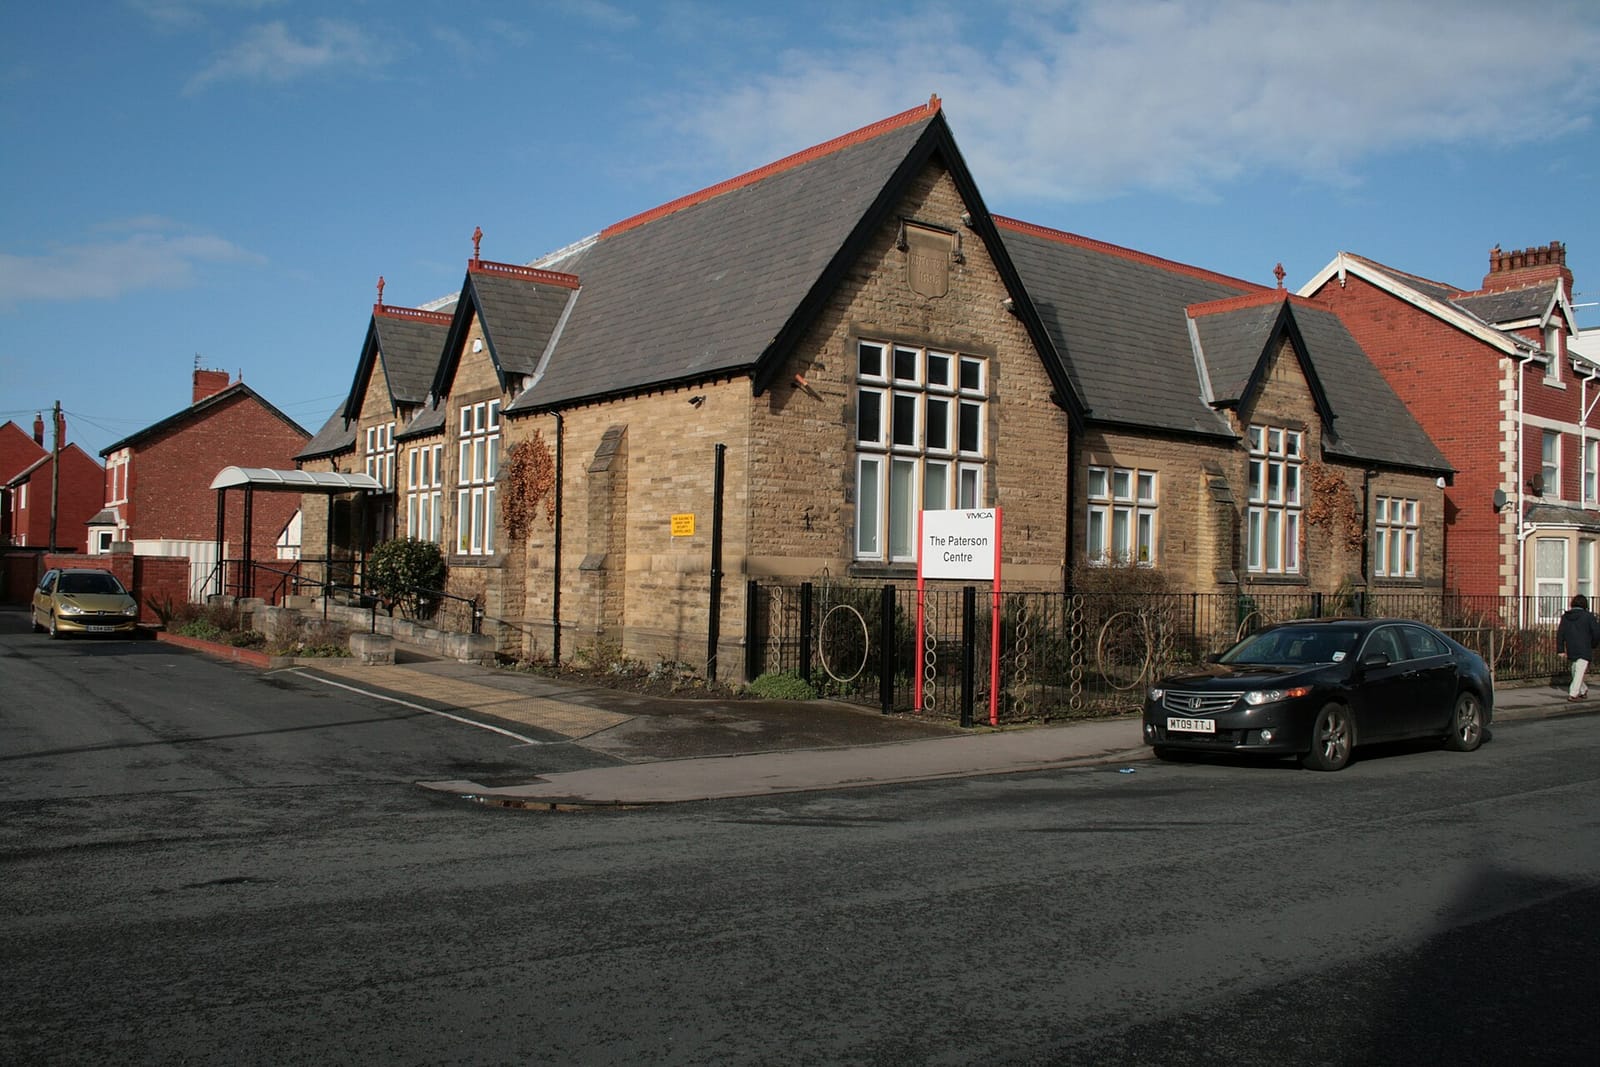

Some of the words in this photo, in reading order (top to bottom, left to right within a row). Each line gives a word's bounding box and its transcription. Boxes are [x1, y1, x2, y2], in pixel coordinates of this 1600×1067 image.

[929, 536, 946, 546] The
[948, 535, 988, 546] Paterson
[943, 551, 973, 562] Centre
[1170, 719, 1192, 729] MT09
[1193, 720, 1212, 730] TTJ
